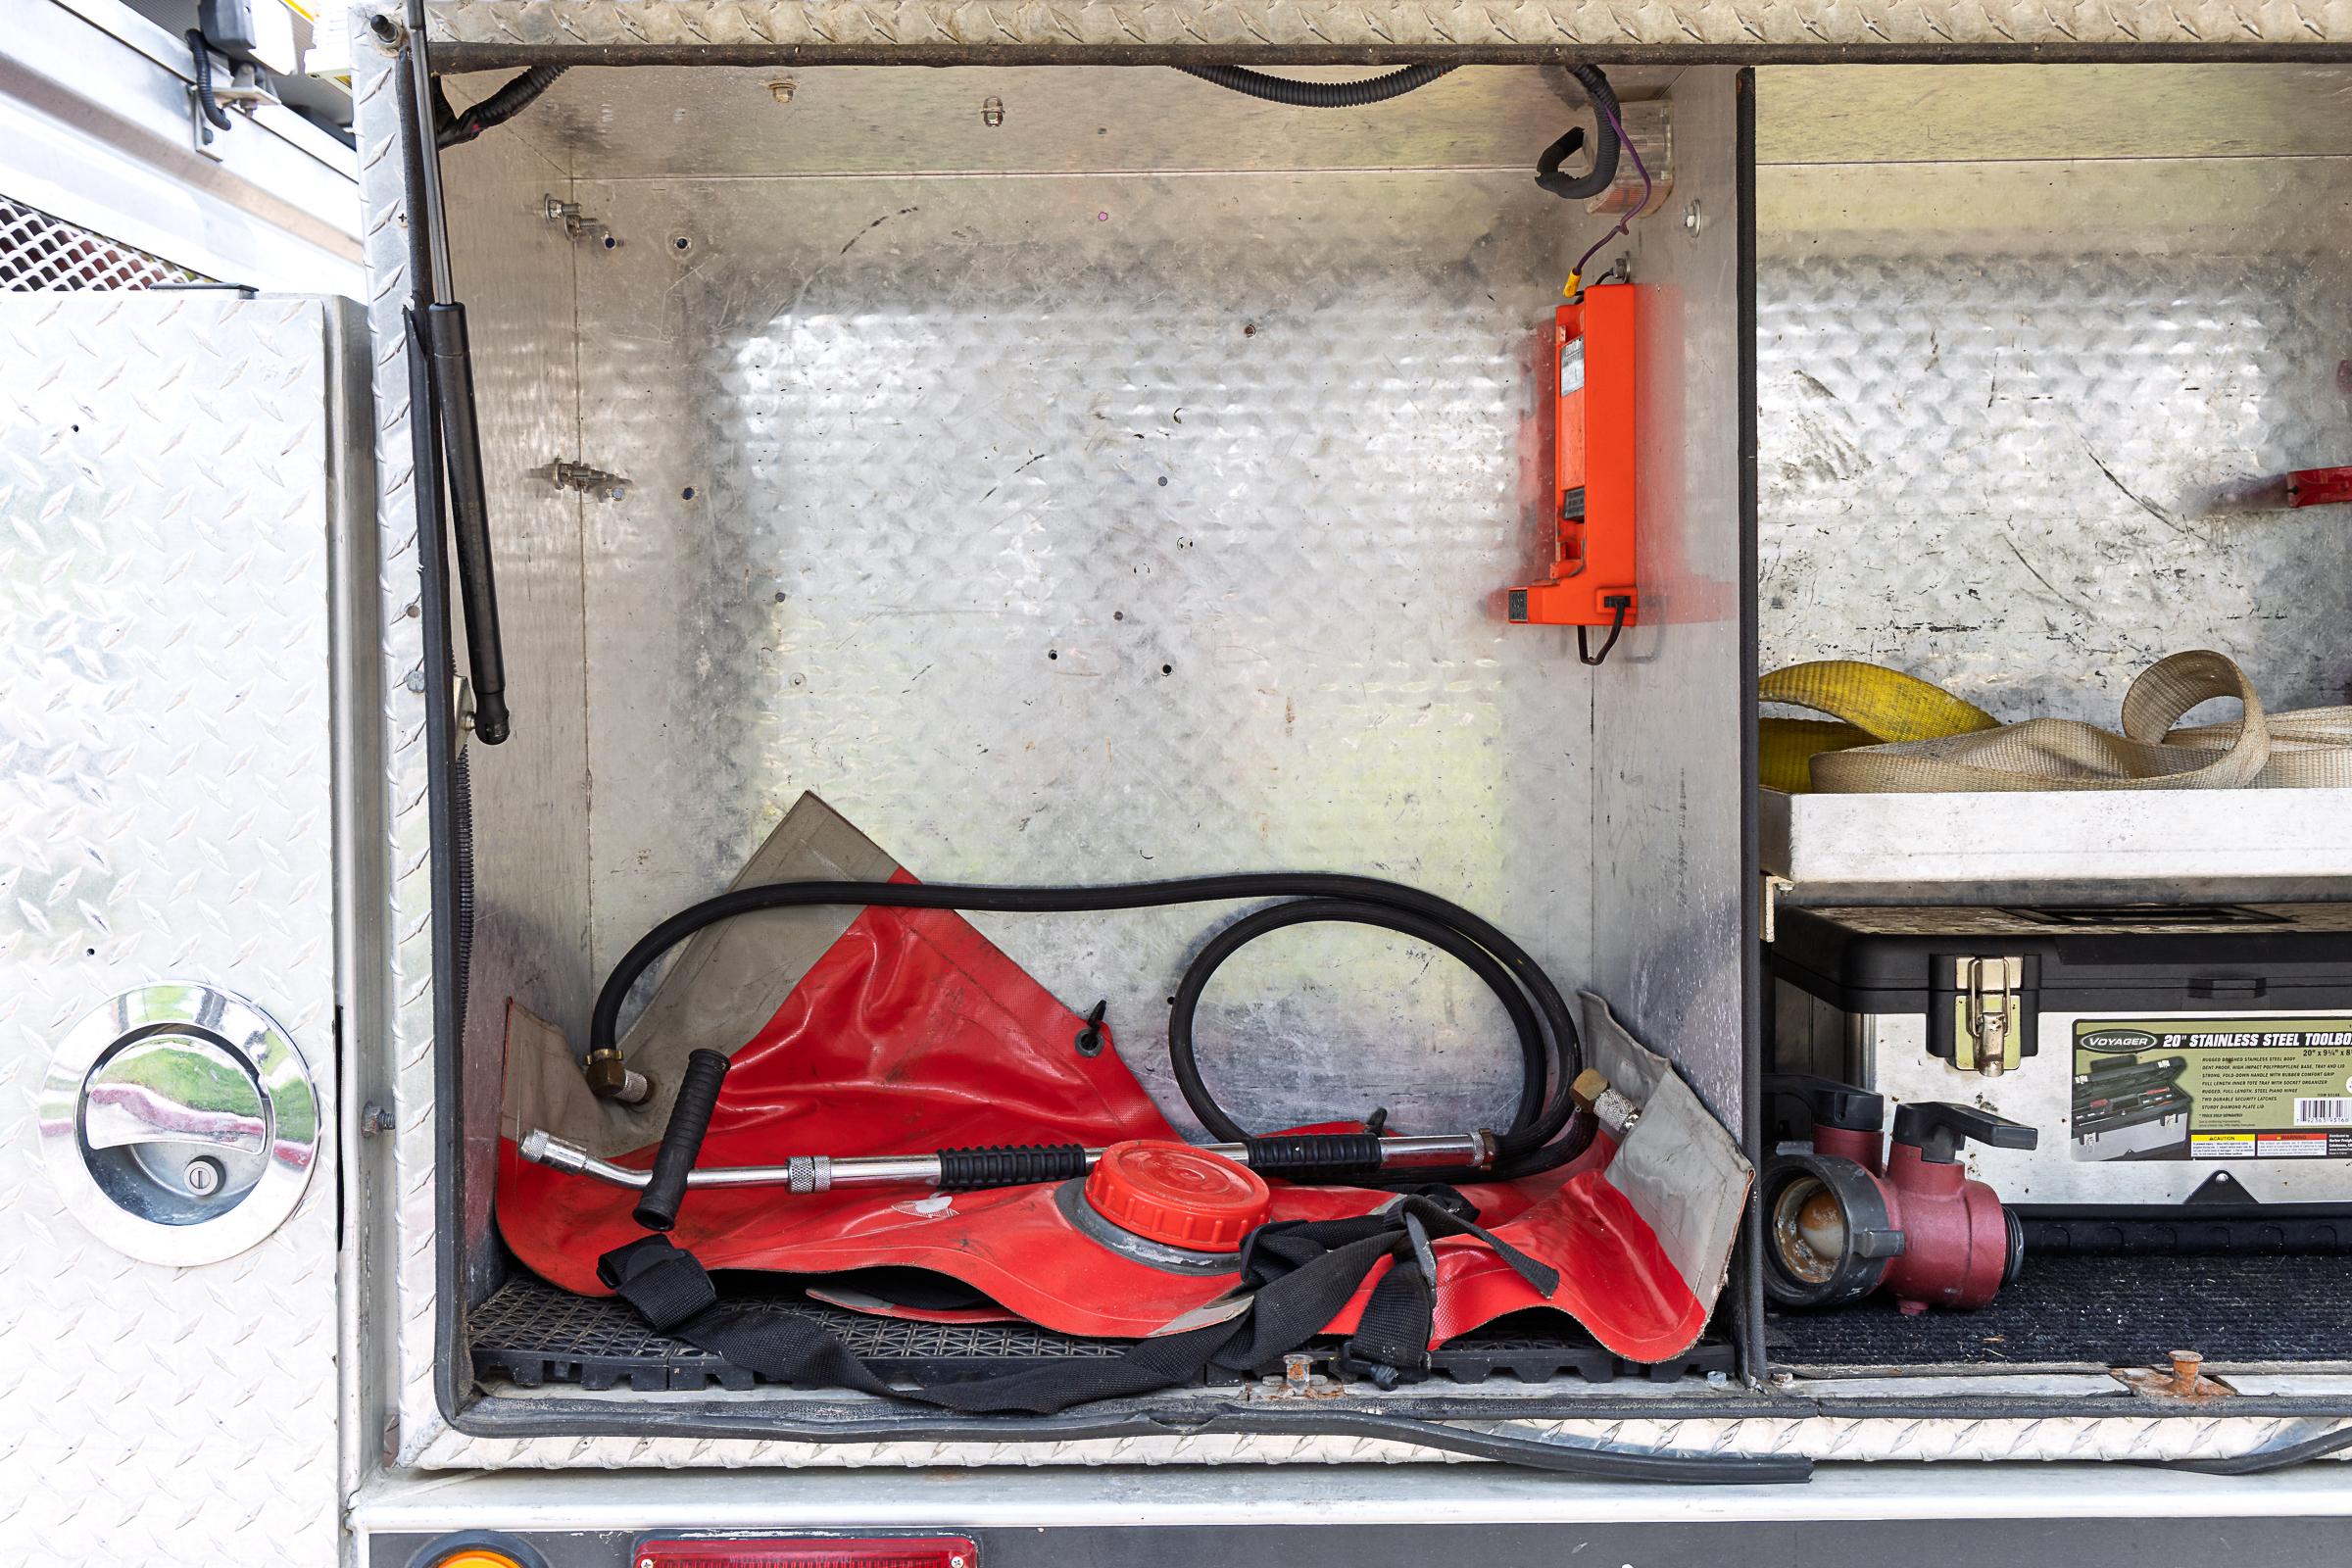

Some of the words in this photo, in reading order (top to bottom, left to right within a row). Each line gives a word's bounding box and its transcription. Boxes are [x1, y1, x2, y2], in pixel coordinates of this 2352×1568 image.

[2163, 1034, 2186, 1047] 20"
[2189, 1033, 2259, 1047] STAINLESS
[2263, 1033, 2300, 1047] STEEL
[2305, 1032, 2352, 1046] TOOLBO
